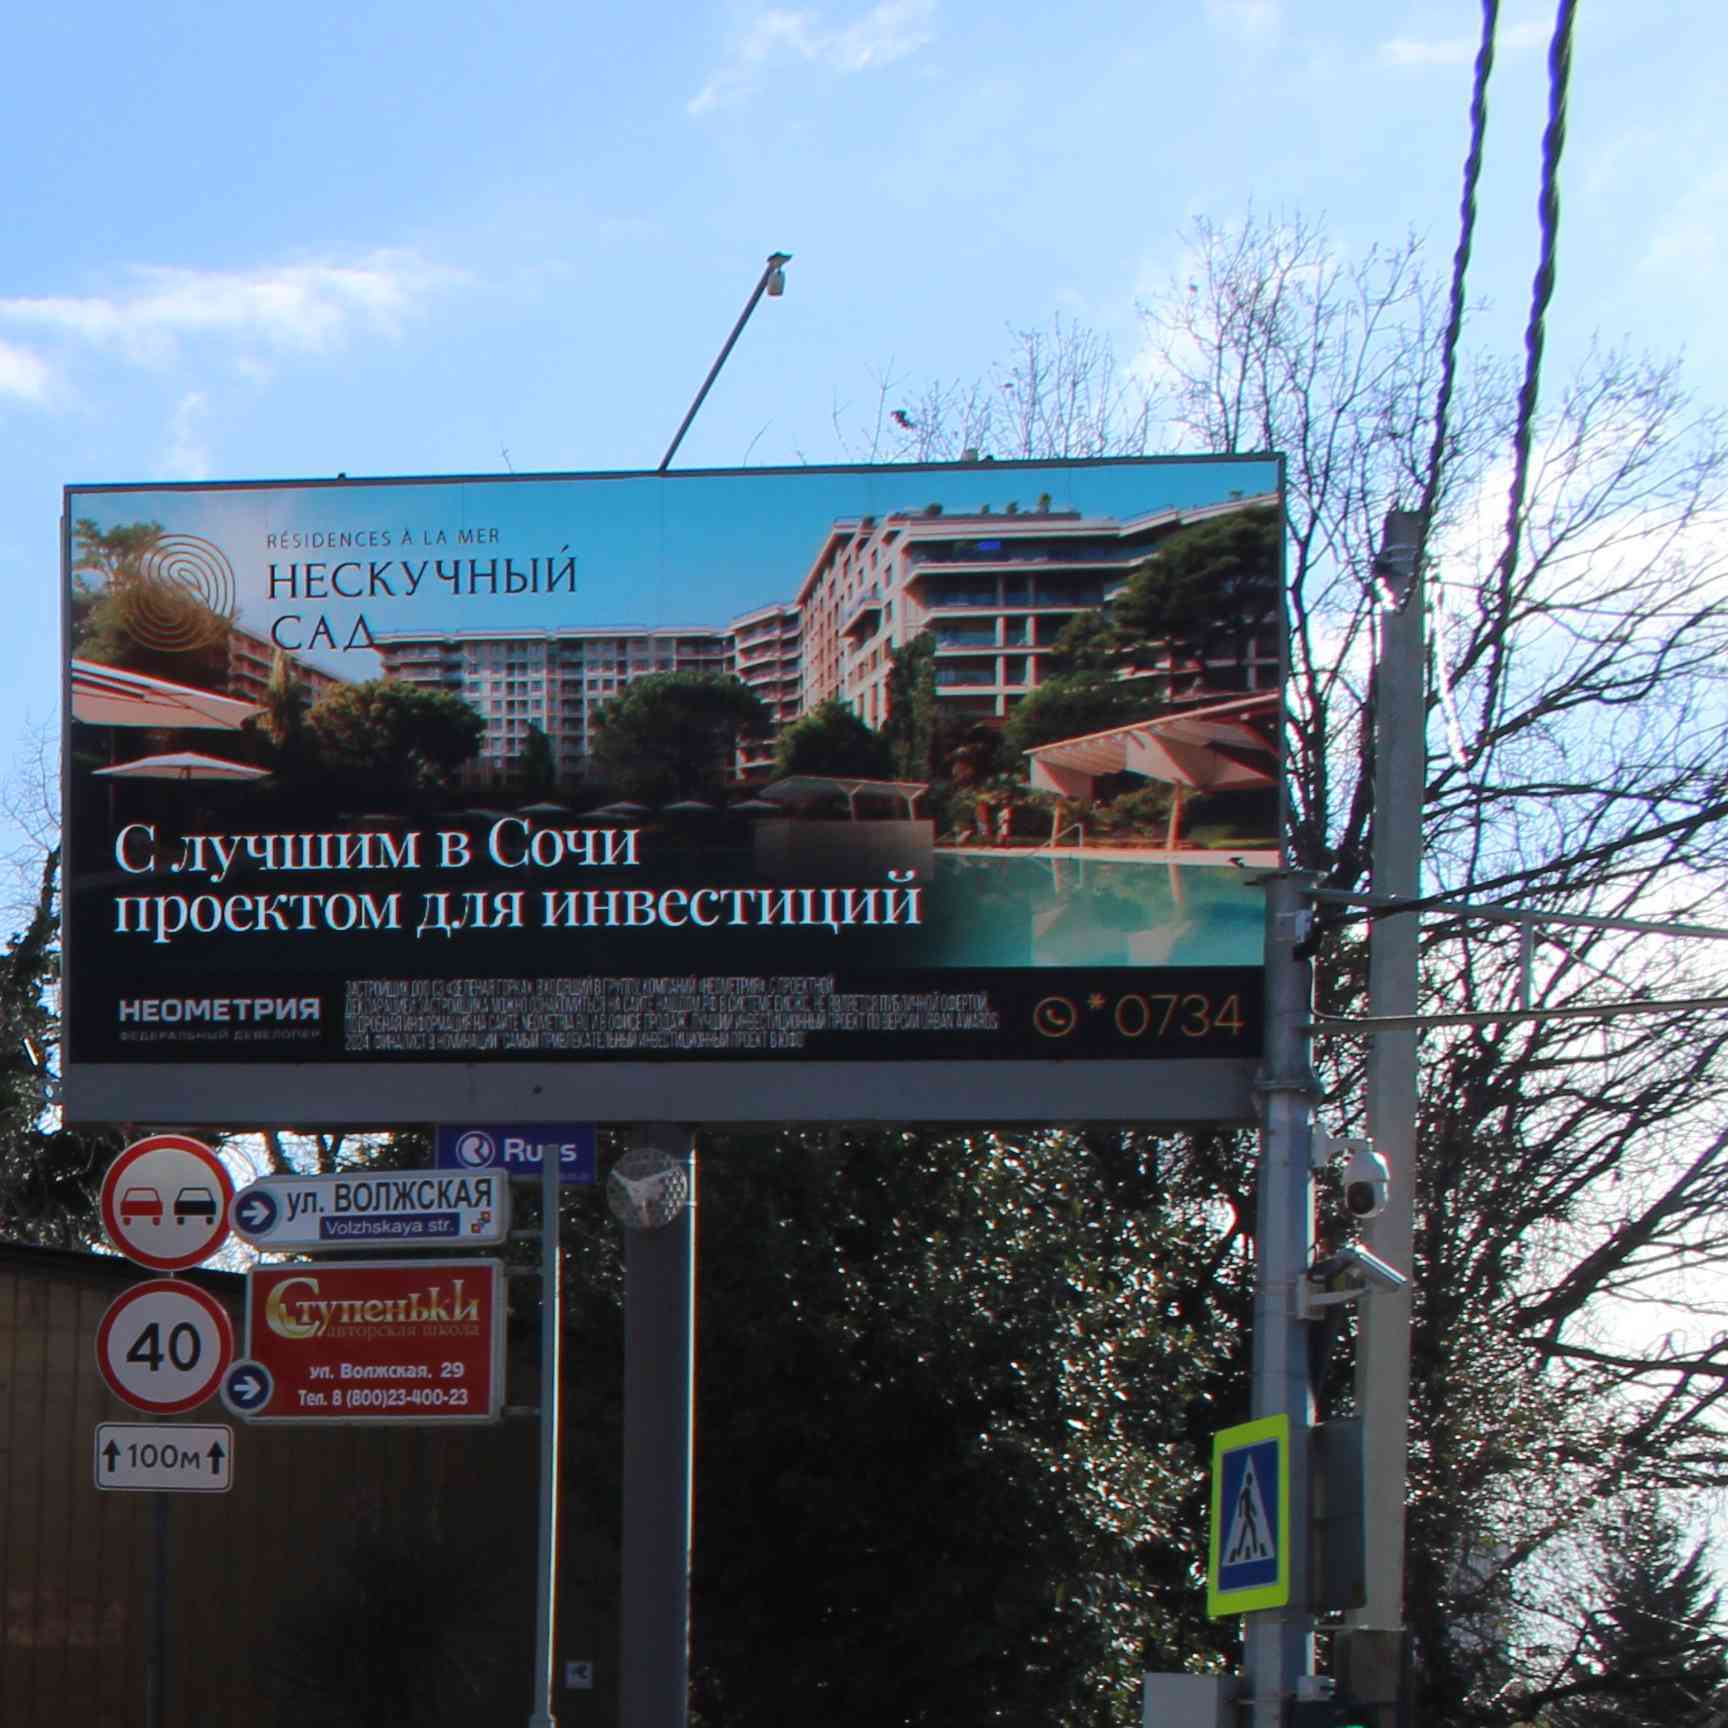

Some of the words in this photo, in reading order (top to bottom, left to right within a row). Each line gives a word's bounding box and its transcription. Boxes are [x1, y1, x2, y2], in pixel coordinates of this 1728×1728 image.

[267, 530, 391, 549] RÉSIDENCES
[402, 528, 413, 545] À
[424, 529, 447, 545] LA
[458, 528, 500, 544] MER
[268, 544, 577, 600] НЕСКУЧНЫЙ
[271, 614, 375, 652] САД
[115, 824, 155, 872] С
[171, 833, 420, 881] лучшим
[436, 833, 470, 868] в
[488, 817, 640, 869] Сочи
[113, 892, 401, 943] проектом
[417, 888, 524, 938] для
[541, 867, 922, 935] инвестиций
[119, 998, 321, 1022] НЕОМЕТРИЯ
[504, 1138, 577, 1162] Rus
[287, 1191, 324, 1221] ул.
[334, 1178, 492, 1213] ВОЛЖСКАЯ
[326, 1219, 423, 1237] Volzhskaya
[428, 1218, 455, 1233] str.
[265, 1277, 480, 1339] Ступеньки
[126, 1322, 202, 1372] 40
[309, 1364, 334, 1380] ул.
[440, 1361, 464, 1378] 29
[298, 1389, 328, 1406] Тел.
[332, 1389, 342, 1406] 8
[346, 1387, 469, 1408] (800)23-400-23
